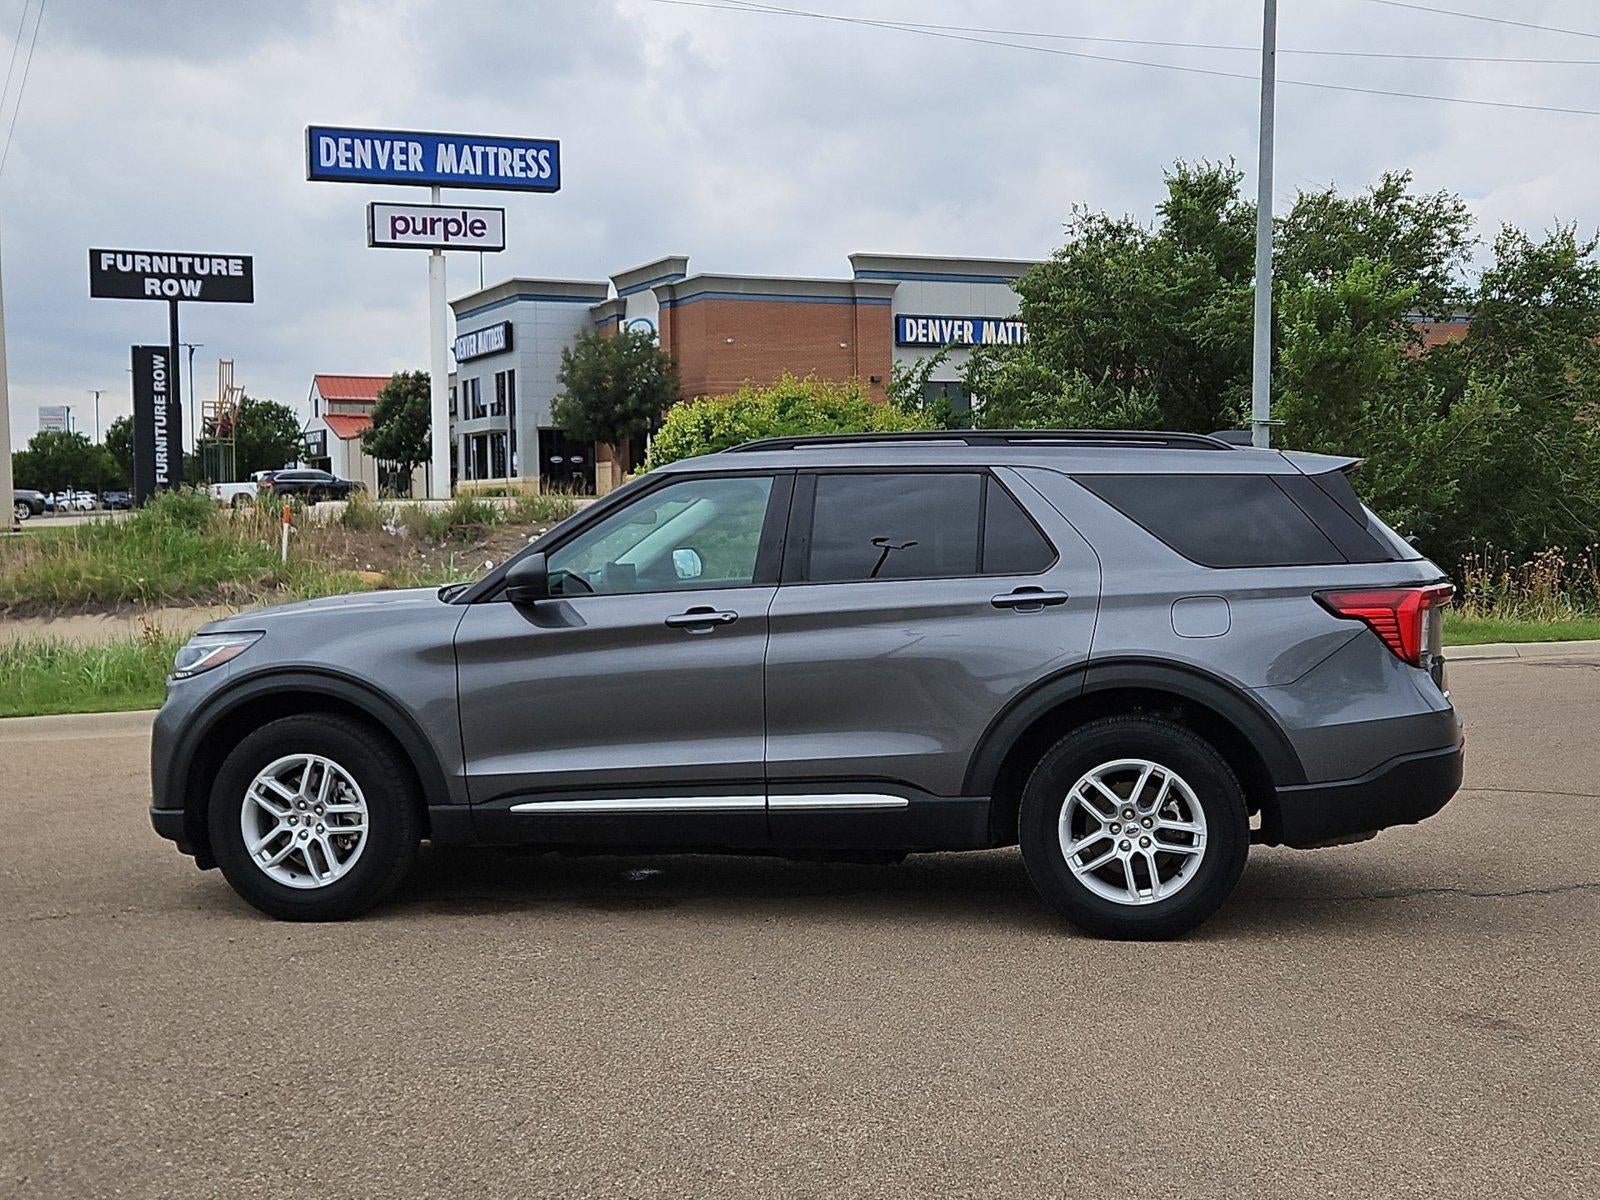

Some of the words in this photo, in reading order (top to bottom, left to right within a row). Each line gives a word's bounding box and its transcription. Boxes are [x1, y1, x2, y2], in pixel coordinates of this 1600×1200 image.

[319, 136, 424, 172] DENVER
[436, 143, 551, 179] MATTRESS
[390, 211, 487, 242] purple
[101, 253, 244, 277] FURNITURE
[144, 278, 202, 297] ROW
[905, 318, 974, 344] DENVER
[456, 334, 477, 361] DENVER
[152, 354, 166, 392] ROW
[153, 395, 169, 484] FURNITURE
